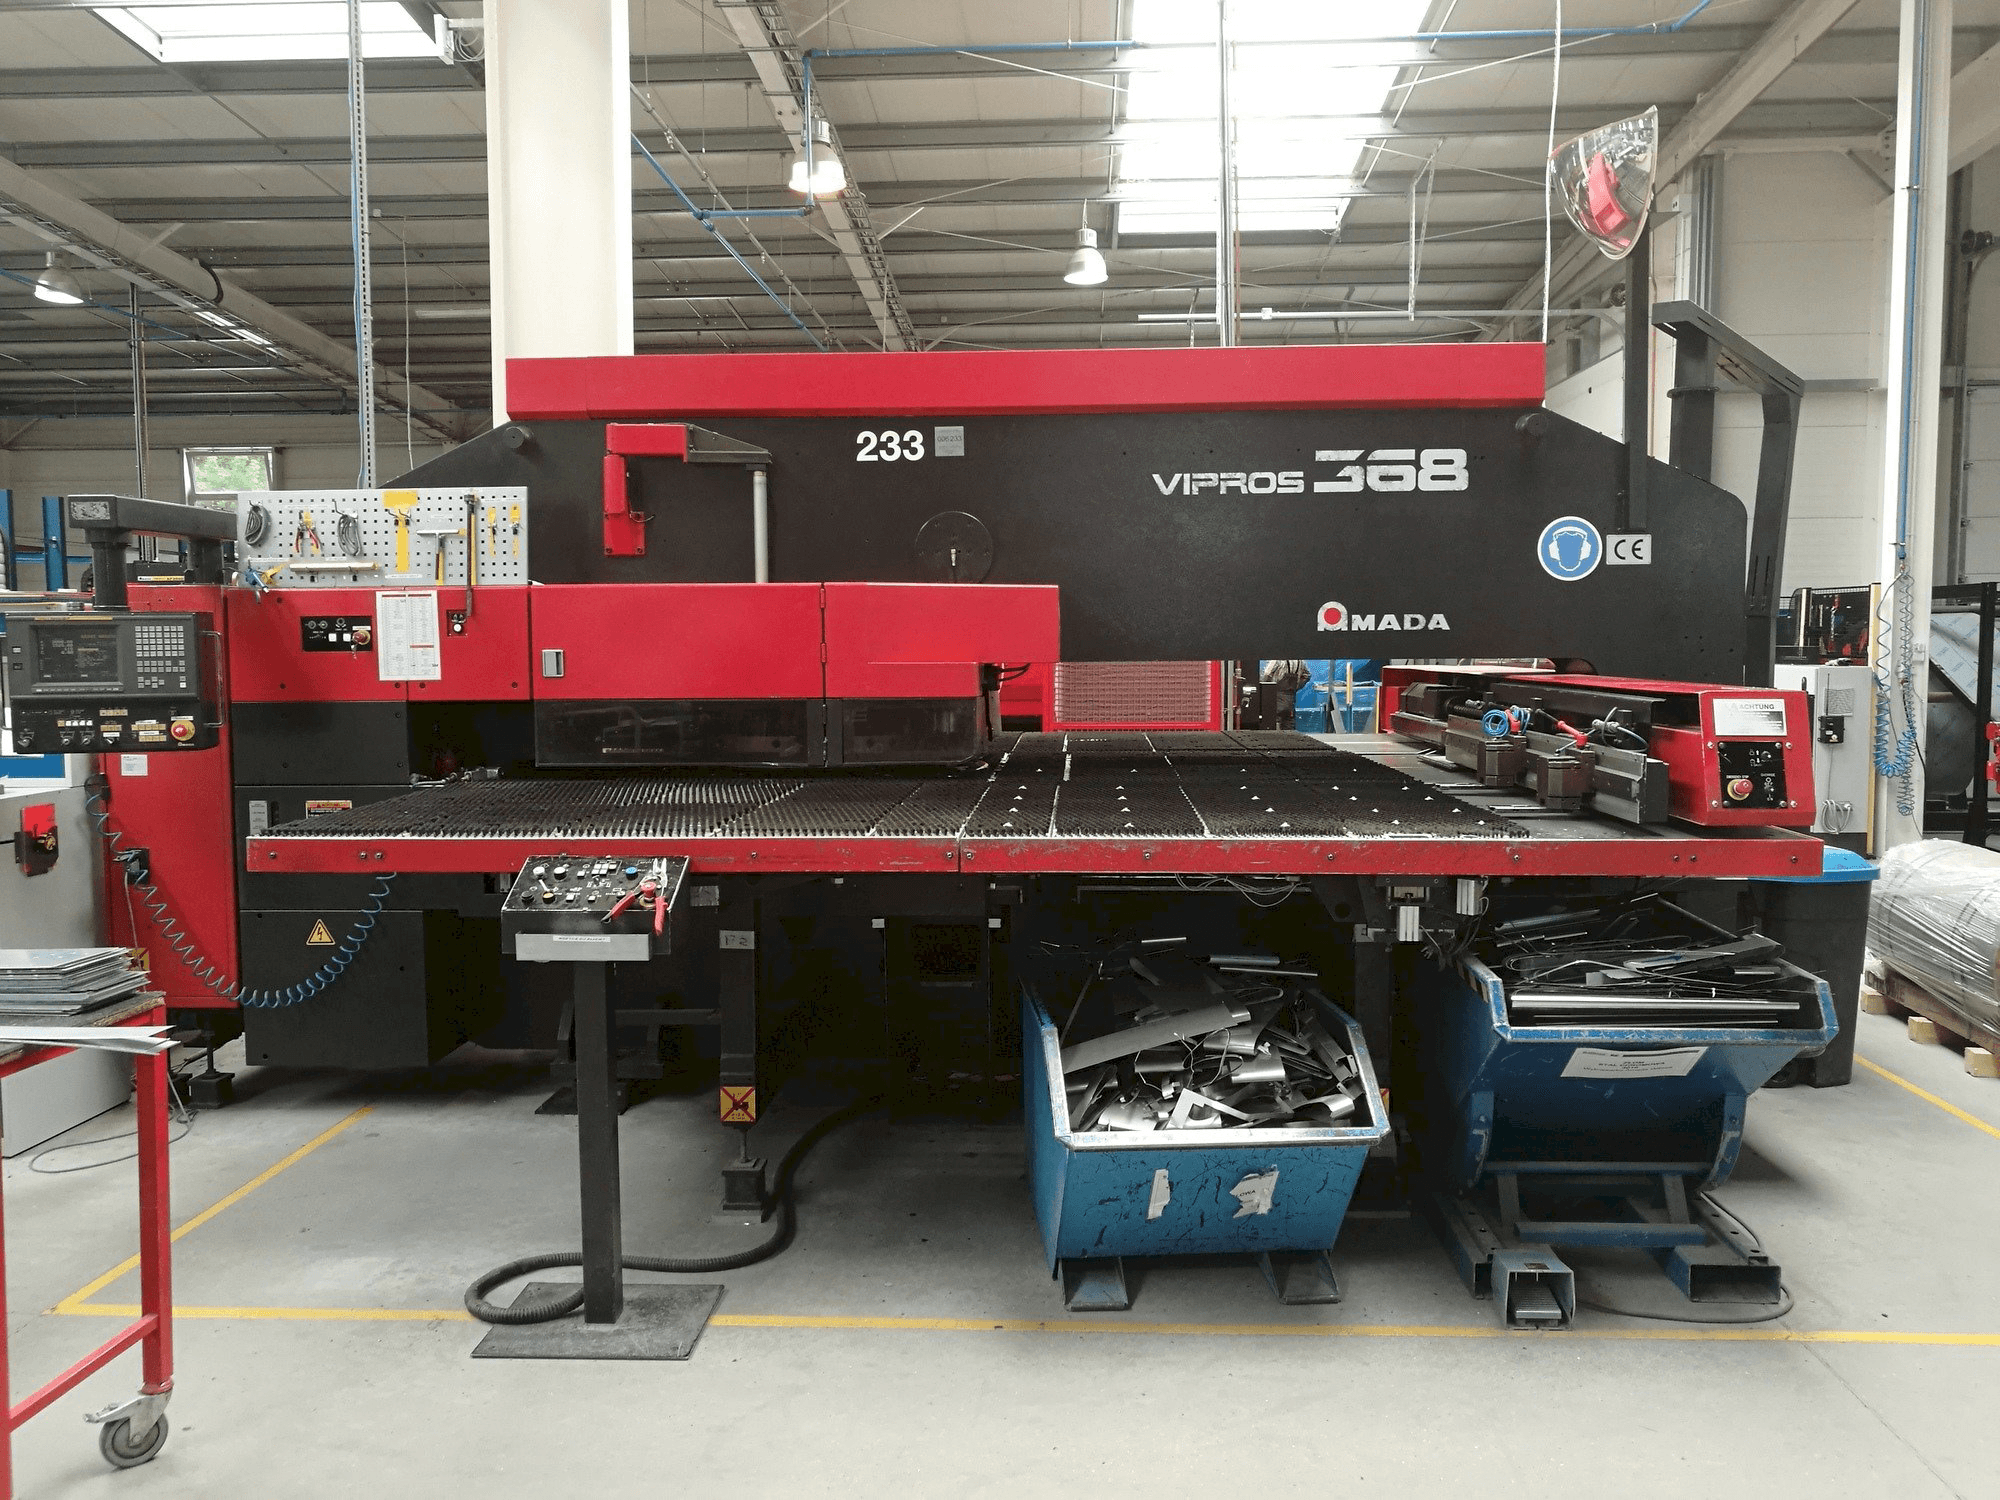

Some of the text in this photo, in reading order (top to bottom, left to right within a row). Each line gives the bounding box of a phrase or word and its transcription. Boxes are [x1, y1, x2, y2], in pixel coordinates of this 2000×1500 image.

[856, 429, 925, 462] 233
[1151, 448, 1470, 496] VIPROS 368
[1614, 538, 1644, 561] CE
[1316, 600, 1451, 632] AMADA
